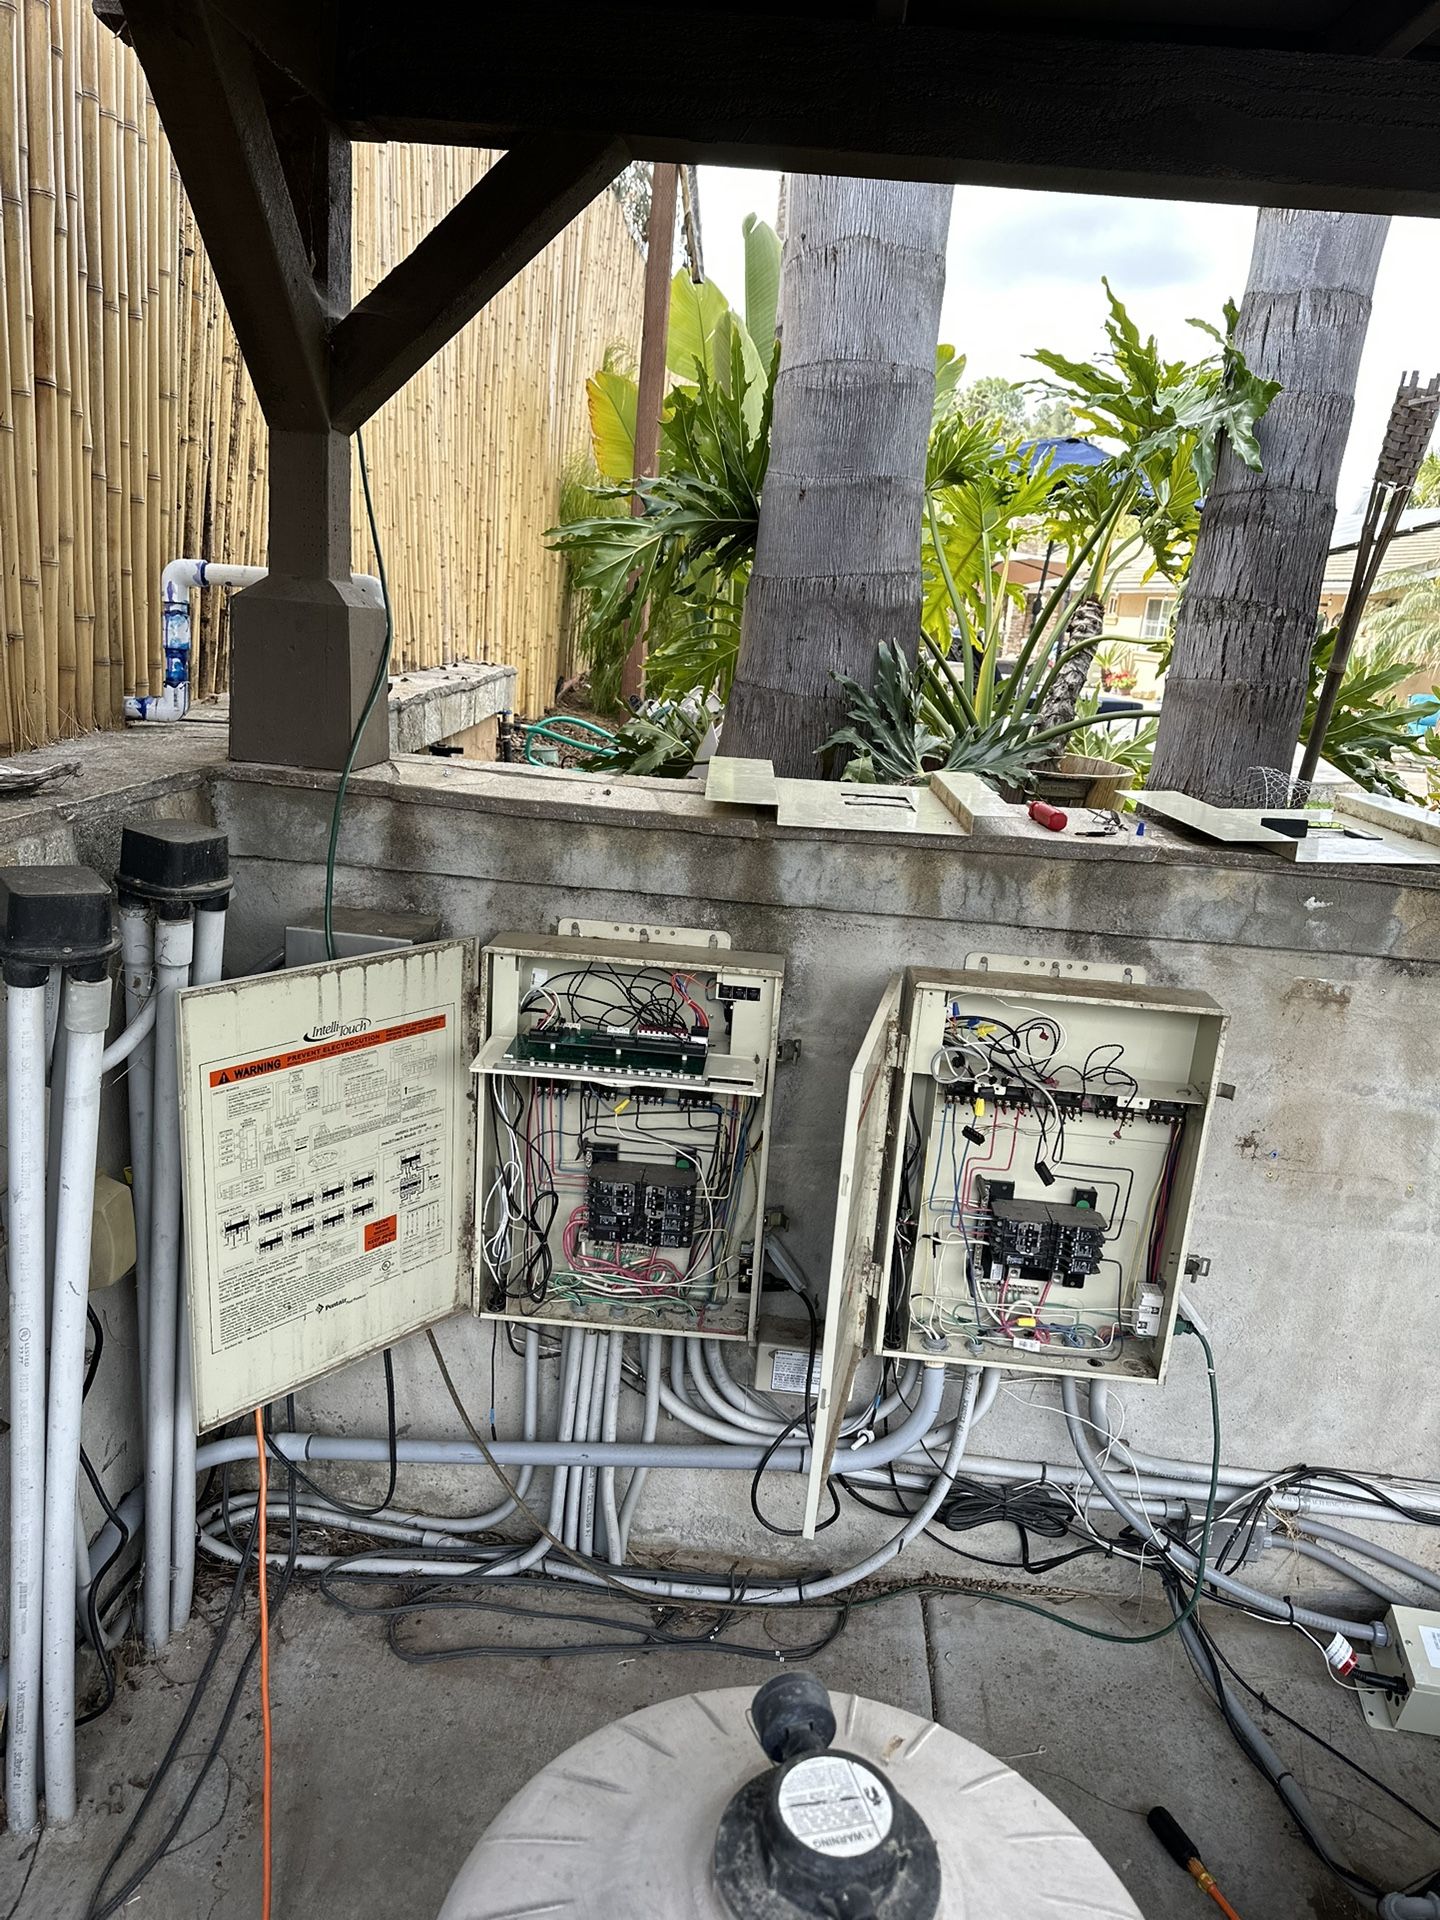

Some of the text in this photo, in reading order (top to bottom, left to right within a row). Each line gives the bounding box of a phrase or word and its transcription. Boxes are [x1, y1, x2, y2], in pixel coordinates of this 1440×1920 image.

[287, 1049, 321, 1063] PREVENT
[323, 1035, 380, 1053] ELECTROCUTION
[233, 1059, 281, 1079] WARNING
[813, 1832, 864, 1849] WARNING
